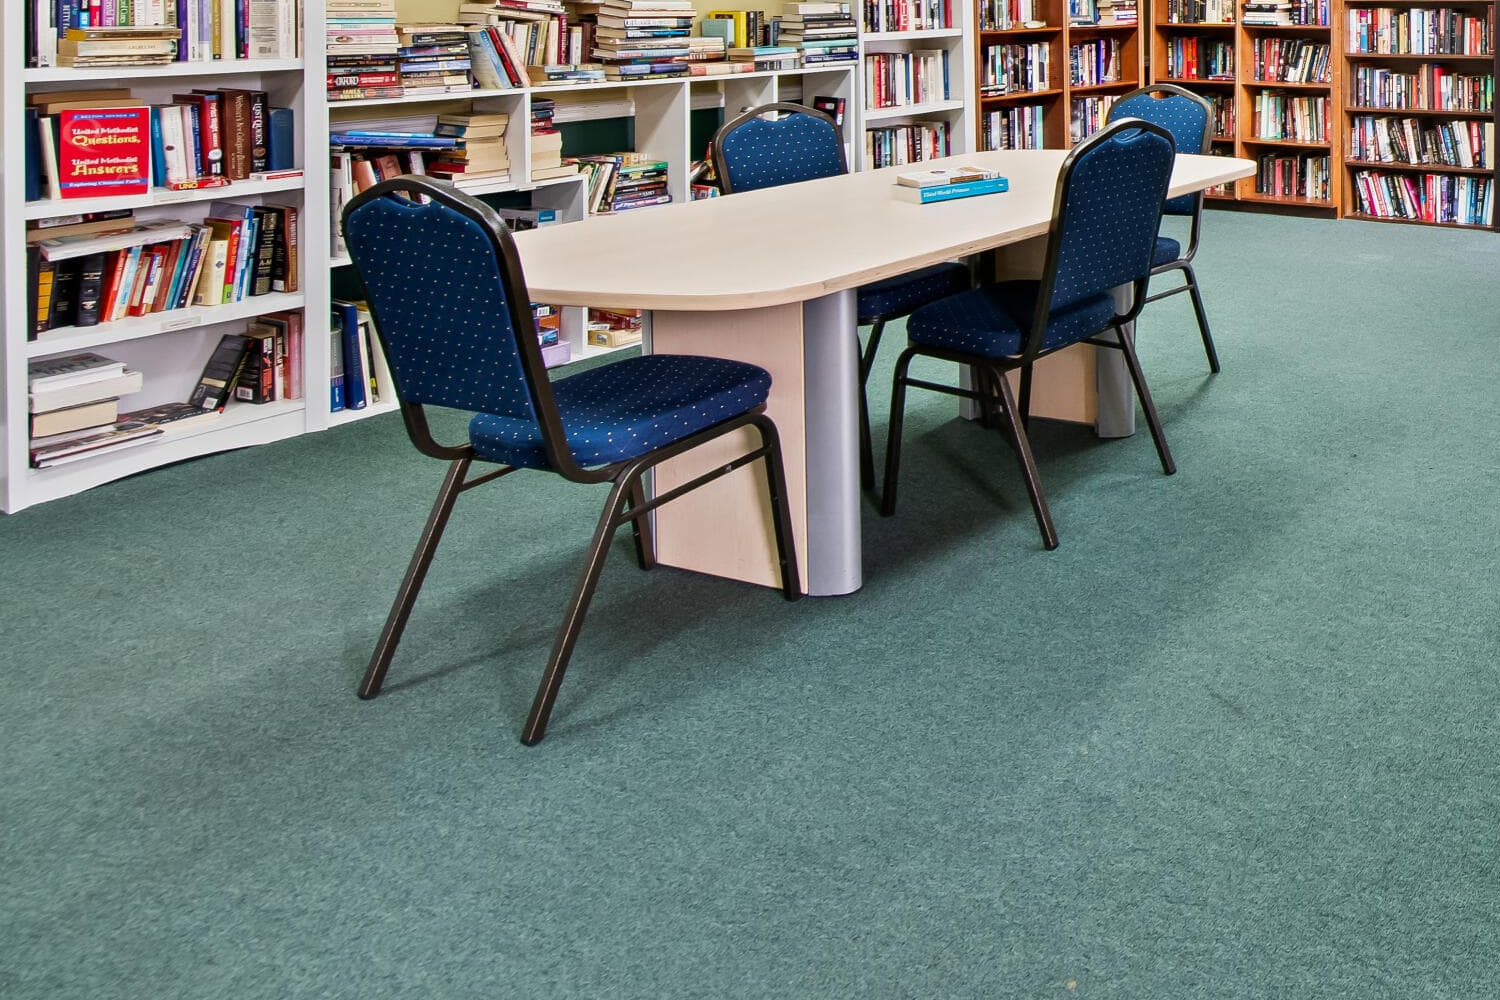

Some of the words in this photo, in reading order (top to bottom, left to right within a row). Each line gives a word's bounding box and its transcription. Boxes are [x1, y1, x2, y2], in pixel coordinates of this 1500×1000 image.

[72, 135, 140, 146] Questions,
[71, 165, 138, 175] Answers
[179, 182, 198, 190] UNO
